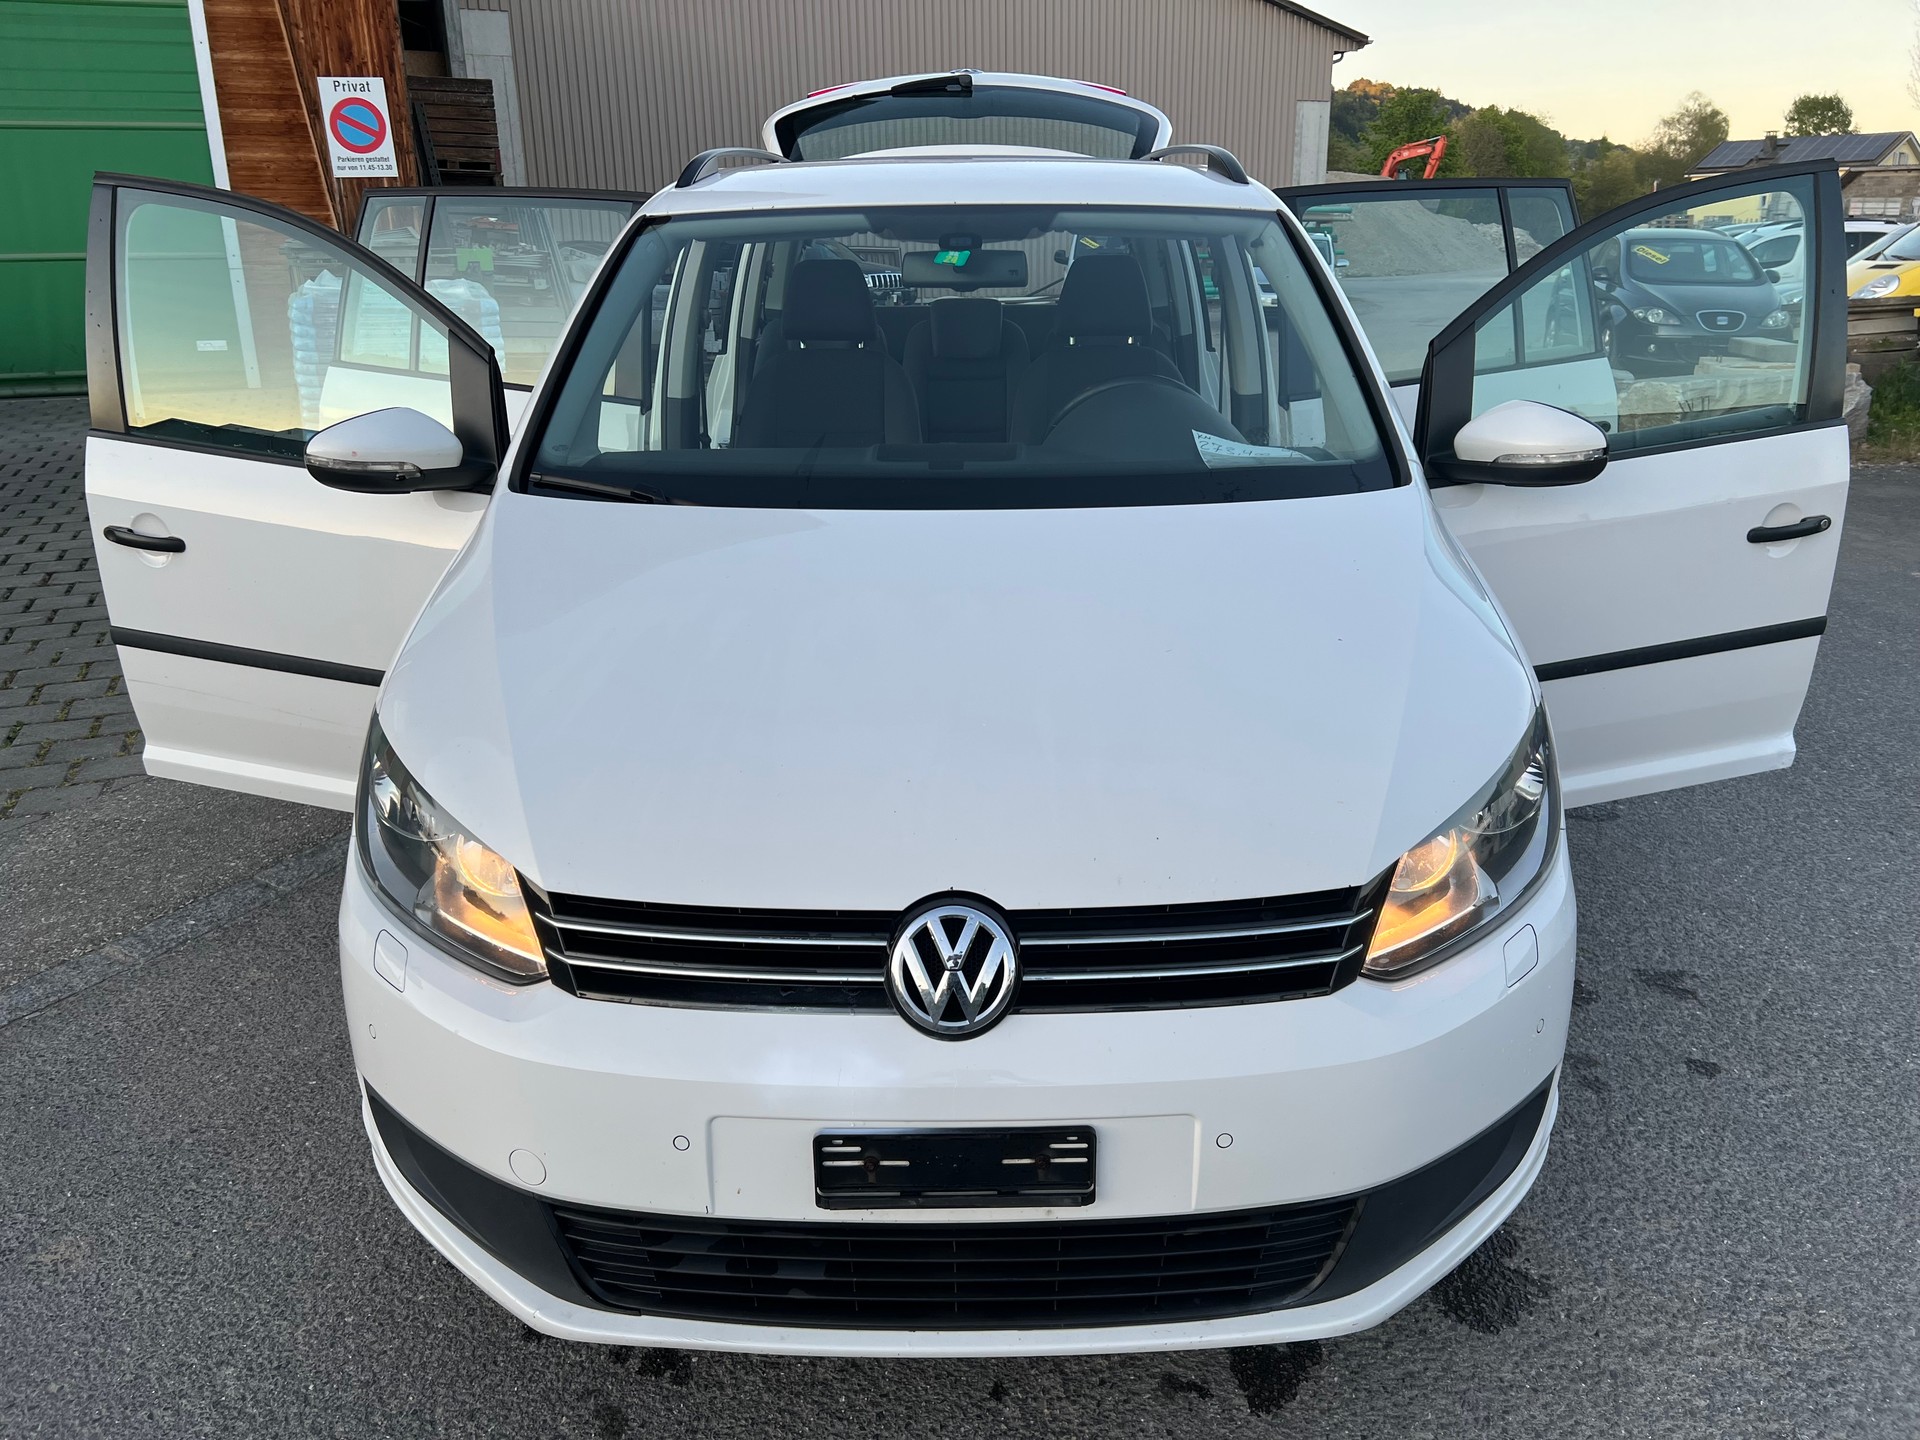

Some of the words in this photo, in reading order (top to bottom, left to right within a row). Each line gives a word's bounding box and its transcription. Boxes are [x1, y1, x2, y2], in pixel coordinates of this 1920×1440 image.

[333, 80, 371, 92] Privat
[1636, 247, 1667, 263] Diesel
[895, 909, 1011, 1029] VW
